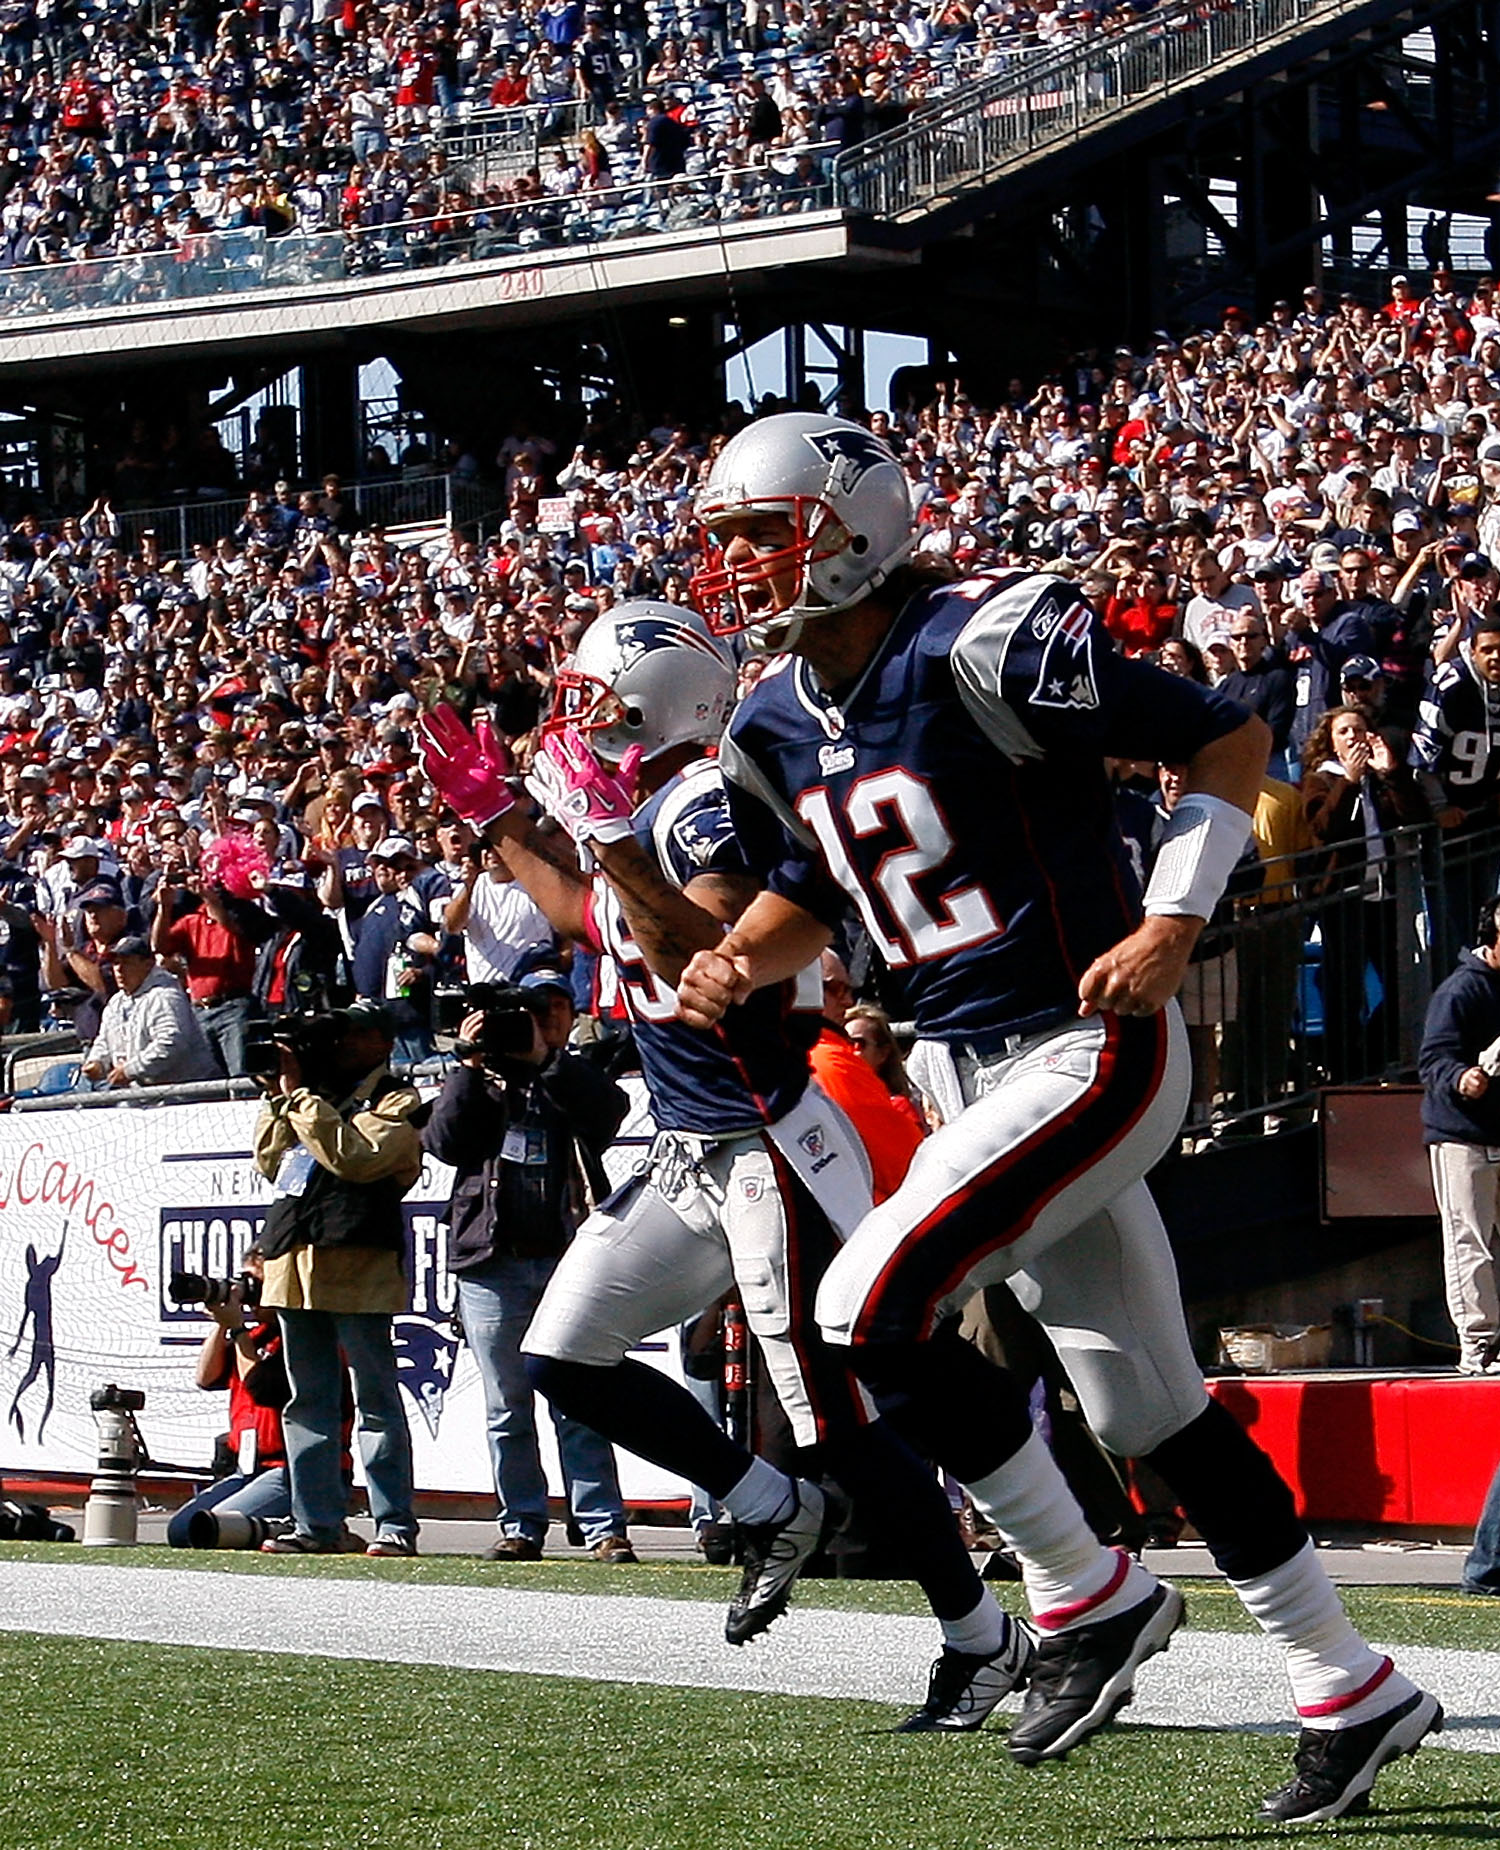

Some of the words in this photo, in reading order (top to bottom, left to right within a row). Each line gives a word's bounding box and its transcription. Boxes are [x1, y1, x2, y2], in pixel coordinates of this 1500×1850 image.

[500, 266, 545, 300] 240
[794, 764, 1006, 968] 12
[210, 1169, 263, 1197] NEW
